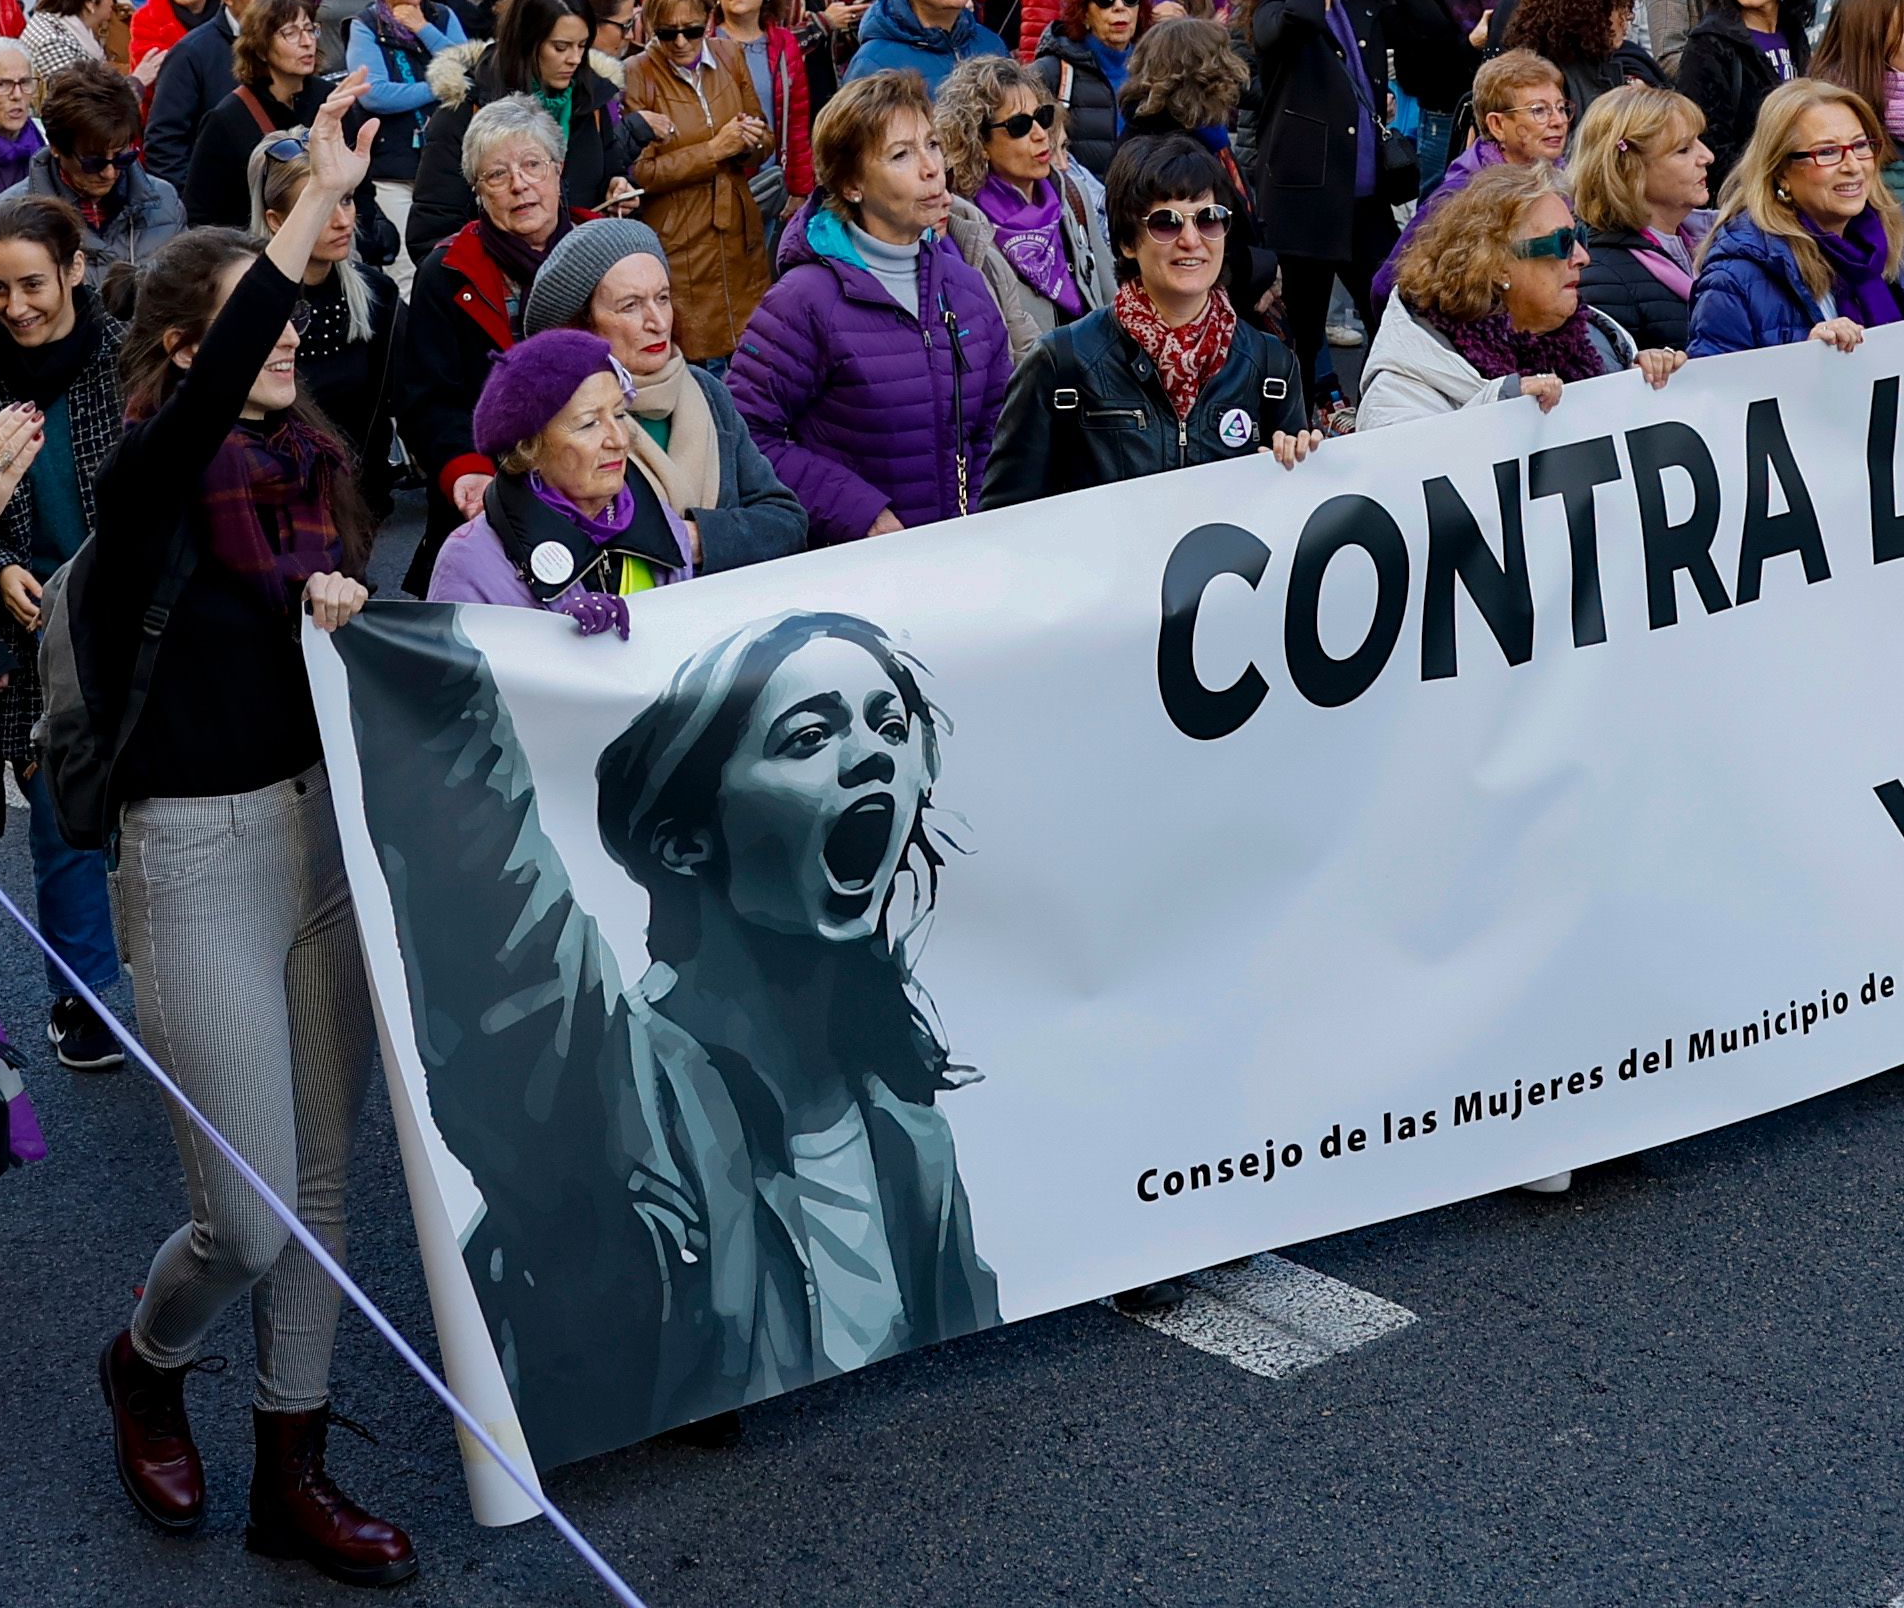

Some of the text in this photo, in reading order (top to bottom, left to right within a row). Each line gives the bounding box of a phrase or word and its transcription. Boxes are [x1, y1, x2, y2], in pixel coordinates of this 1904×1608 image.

[1157, 398, 1832, 741] CONTRA
[1137, 1139, 1303, 1203] Consejo
[1319, 1124, 1367, 1159] de
[1382, 1110, 1439, 1145] las
[1453, 1066, 1604, 1127] Mujeres
[1618, 1038, 1674, 1081] del
[1688, 989, 1850, 1063] Municipio
[1860, 972, 1895, 1005] de
